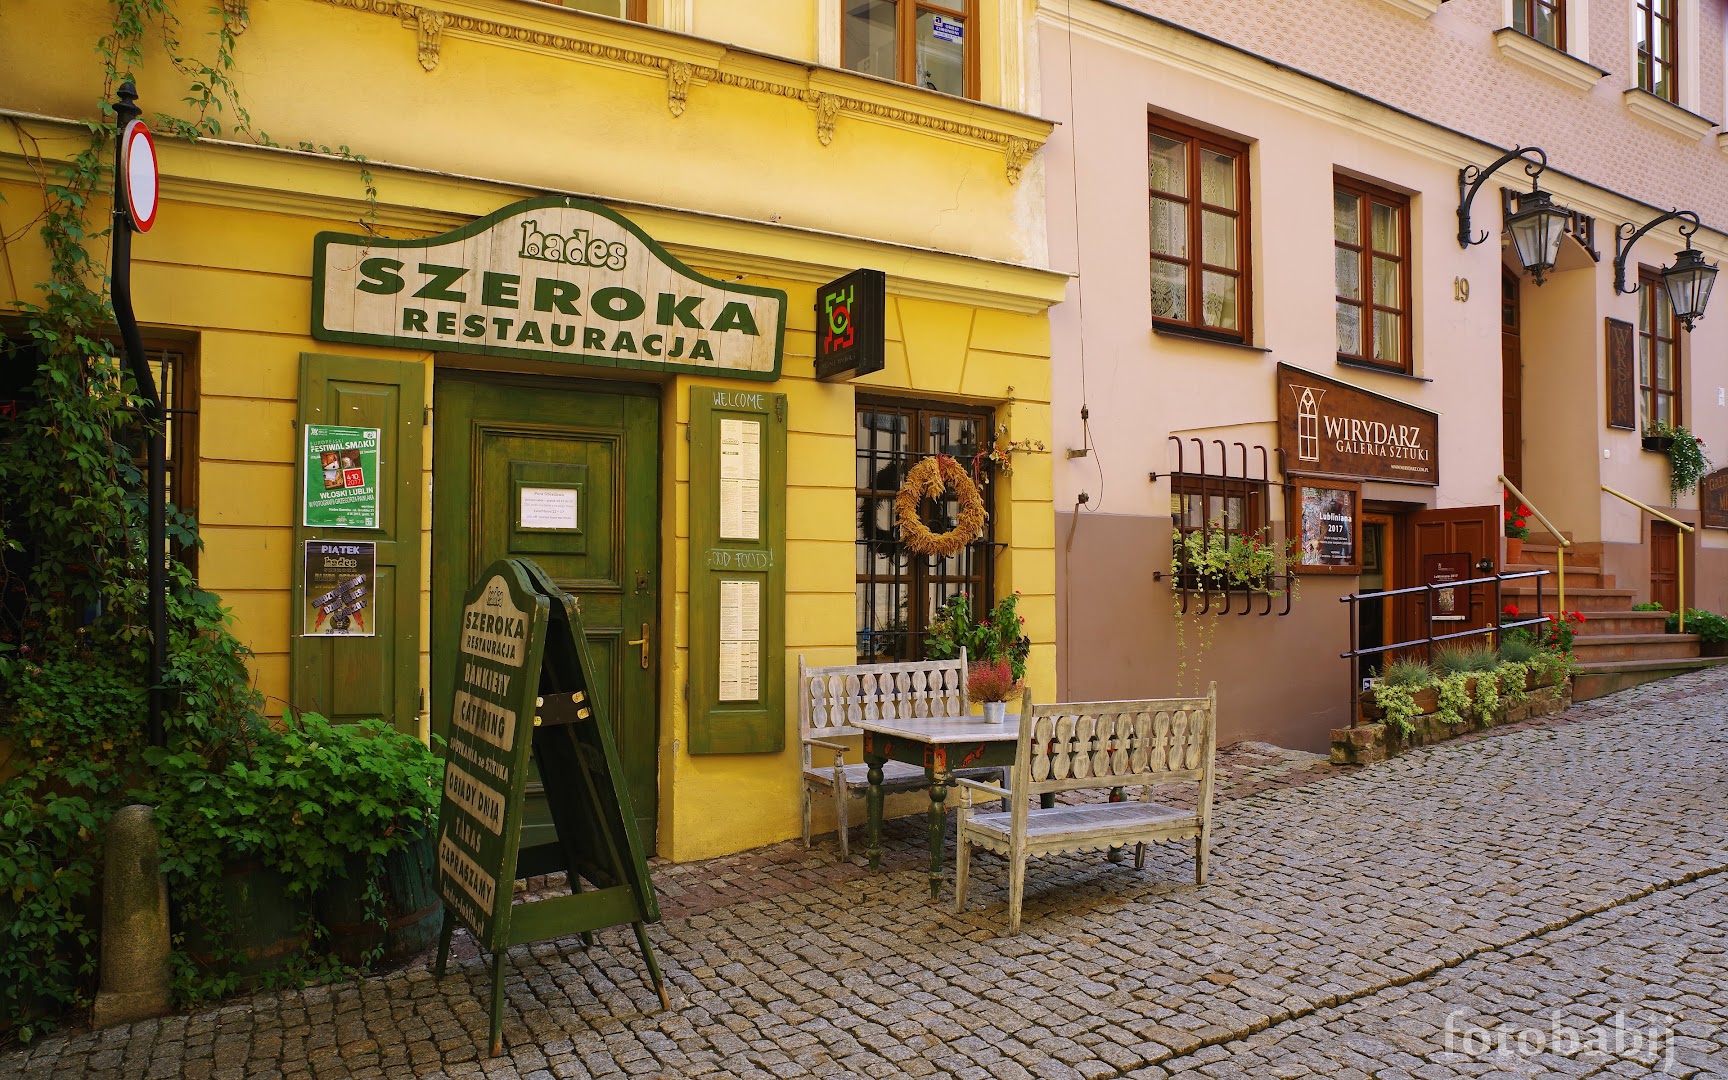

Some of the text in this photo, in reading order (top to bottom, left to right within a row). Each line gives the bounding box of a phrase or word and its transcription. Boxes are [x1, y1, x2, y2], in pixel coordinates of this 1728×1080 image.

[518, 220, 628, 271] hades
[356, 257, 760, 337] SZEROKA
[1454, 276, 1470, 303] 19
[402, 308, 715, 361] RESTAURACJA
[1611, 326, 1630, 421] WAKSMAN
[713, 391, 765, 410] WELCOME
[310, 440, 375, 453] FESTIWAL SMAKU
[1323, 415, 1421, 449] WIRYDARZ
[1335, 440, 1429, 461] GALERIA SZTUKI
[320, 487, 374, 500] WŁOSKI LUBLIN
[1319, 512, 1352, 523] Lubliniana
[1328, 524, 1343, 533] 2017
[321, 545, 360, 556] PIĄTEK
[704, 548, 774, 568] GOOD FOOD!
[465, 611, 524, 640] SZEROKA
[466, 634, 516, 660] RESTAURACJA
[464, 662, 511, 697] BANKIETY
[461, 700, 506, 739] CATERING
[449, 770, 499, 824] OBIADY DNIA
[455, 816, 482, 854] TARAS
[441, 843, 492, 904] ZAPRASZAMY
